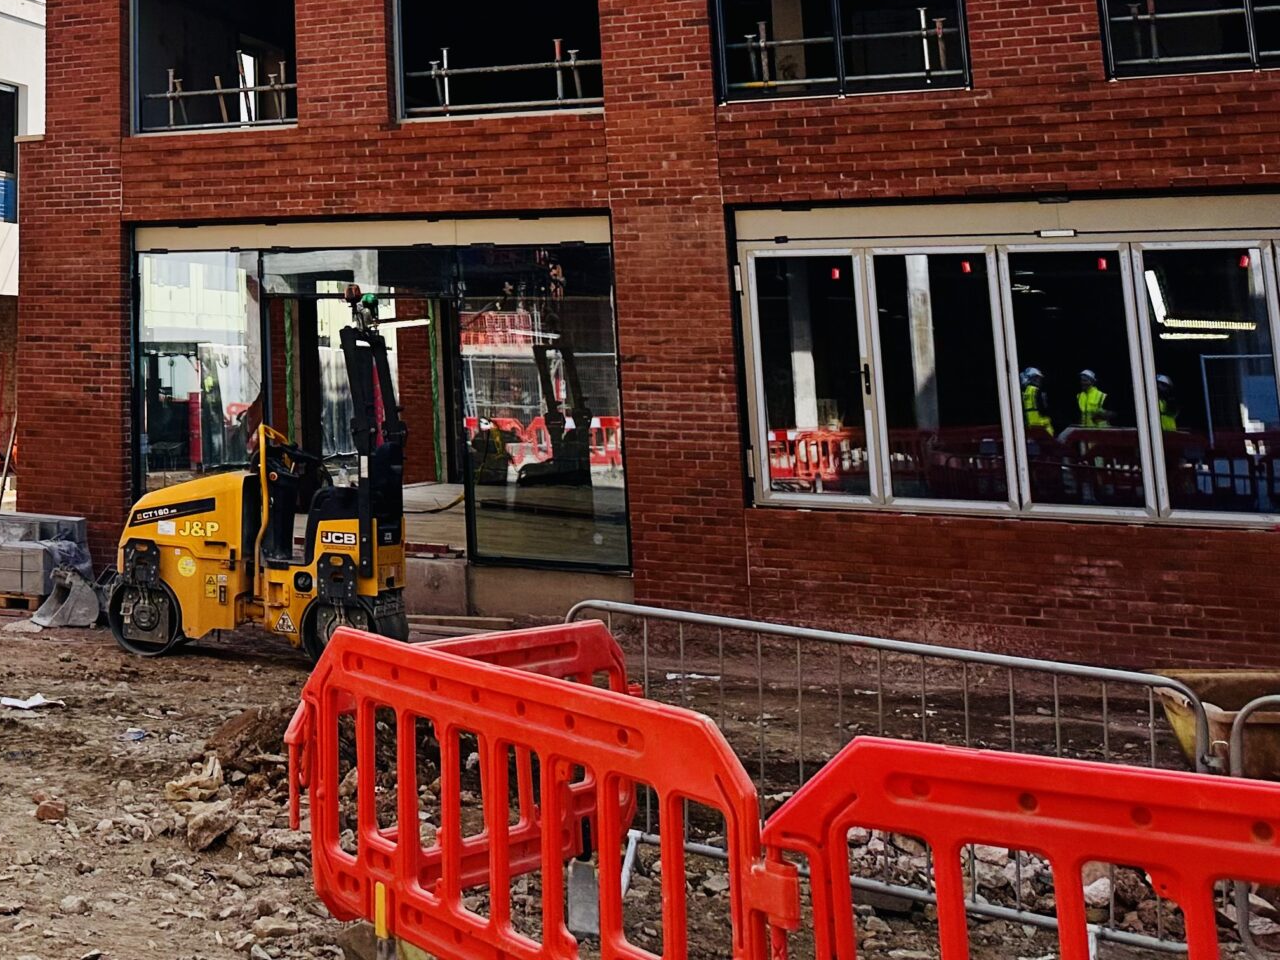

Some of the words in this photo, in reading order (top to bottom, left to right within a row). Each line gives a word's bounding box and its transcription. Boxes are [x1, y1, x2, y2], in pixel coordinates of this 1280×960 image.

[142, 508, 170, 519] CT160
[179, 520, 219, 537] J&P
[322, 532, 356, 544] JCB
